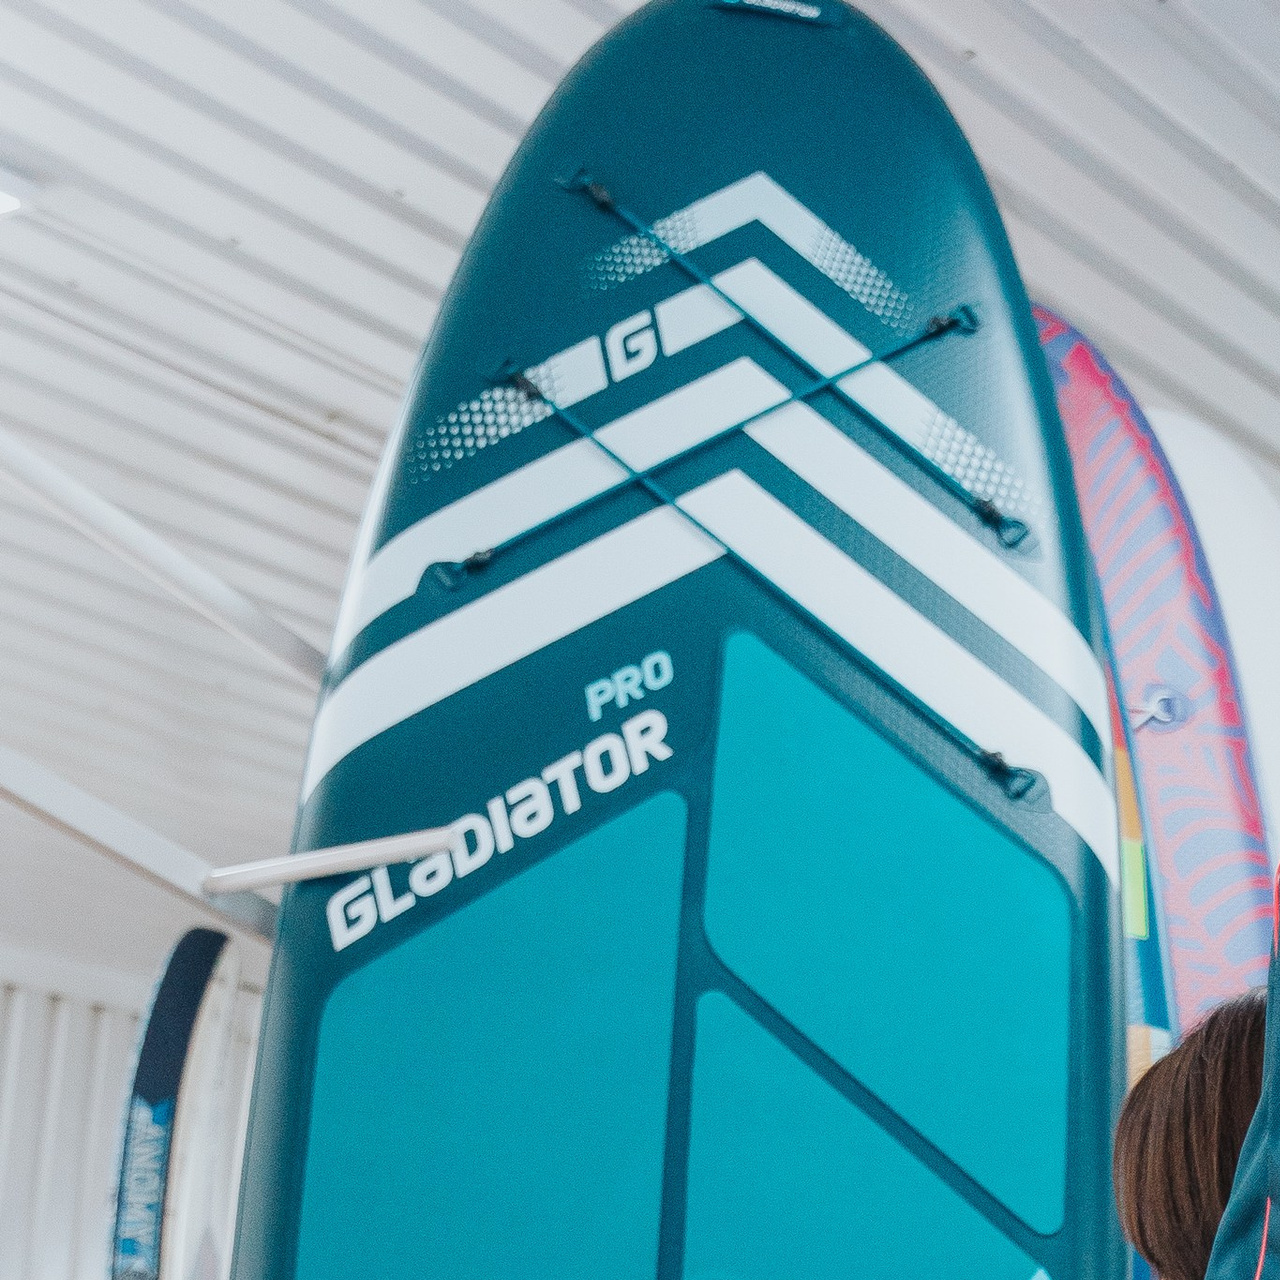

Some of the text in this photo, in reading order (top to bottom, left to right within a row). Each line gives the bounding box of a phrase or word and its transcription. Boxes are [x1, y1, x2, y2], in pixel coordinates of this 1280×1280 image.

[604, 308, 658, 383] G
[584, 649, 675, 723] PRO
[326, 708, 674, 952] GLADIATOR
